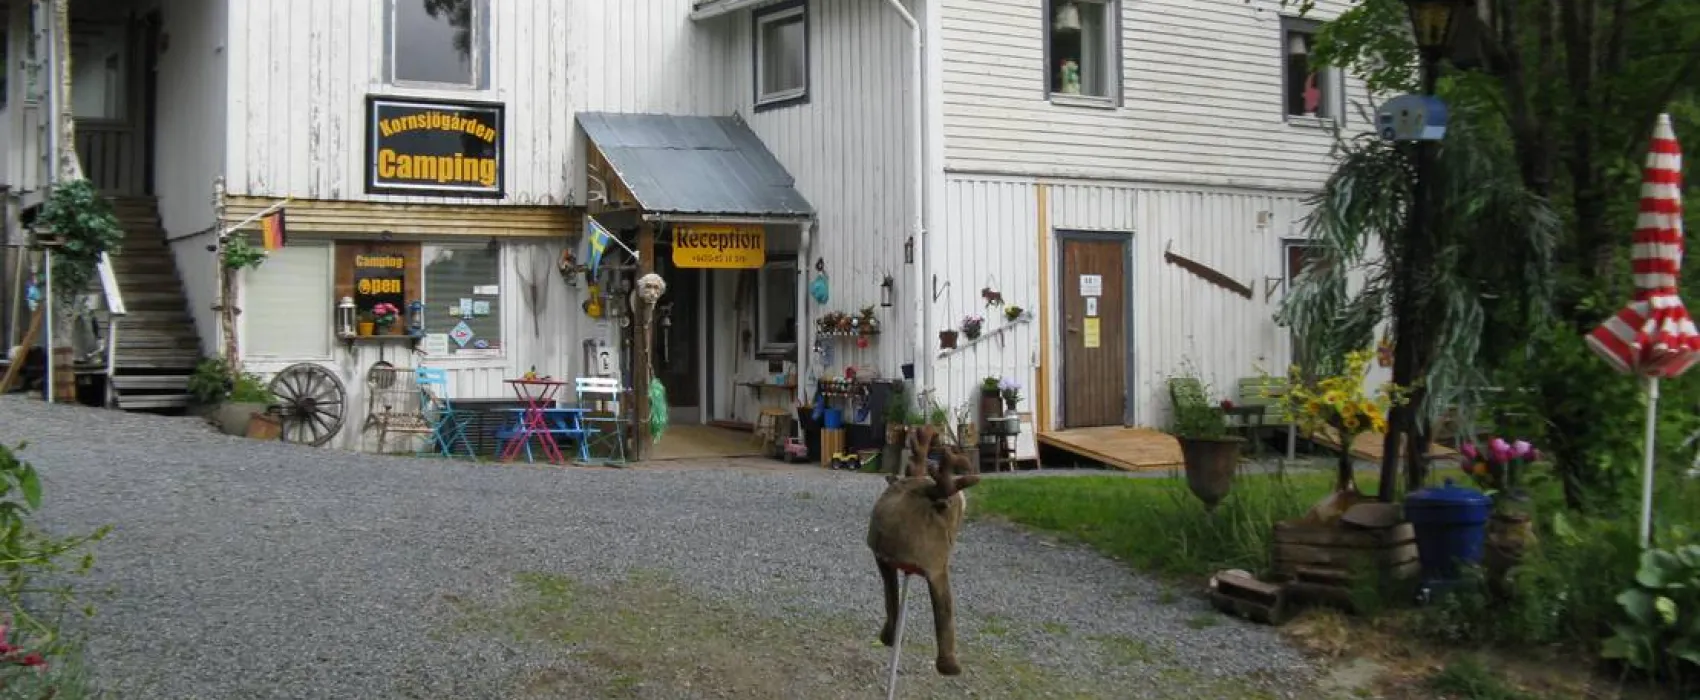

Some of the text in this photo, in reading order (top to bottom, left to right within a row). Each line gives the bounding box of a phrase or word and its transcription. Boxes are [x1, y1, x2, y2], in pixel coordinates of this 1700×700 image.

[380, 112, 496, 142] Kornsjögården
[379, 149, 496, 186] Camping
[676, 227, 761, 252] Reception
[356, 255, 403, 268] Camping
